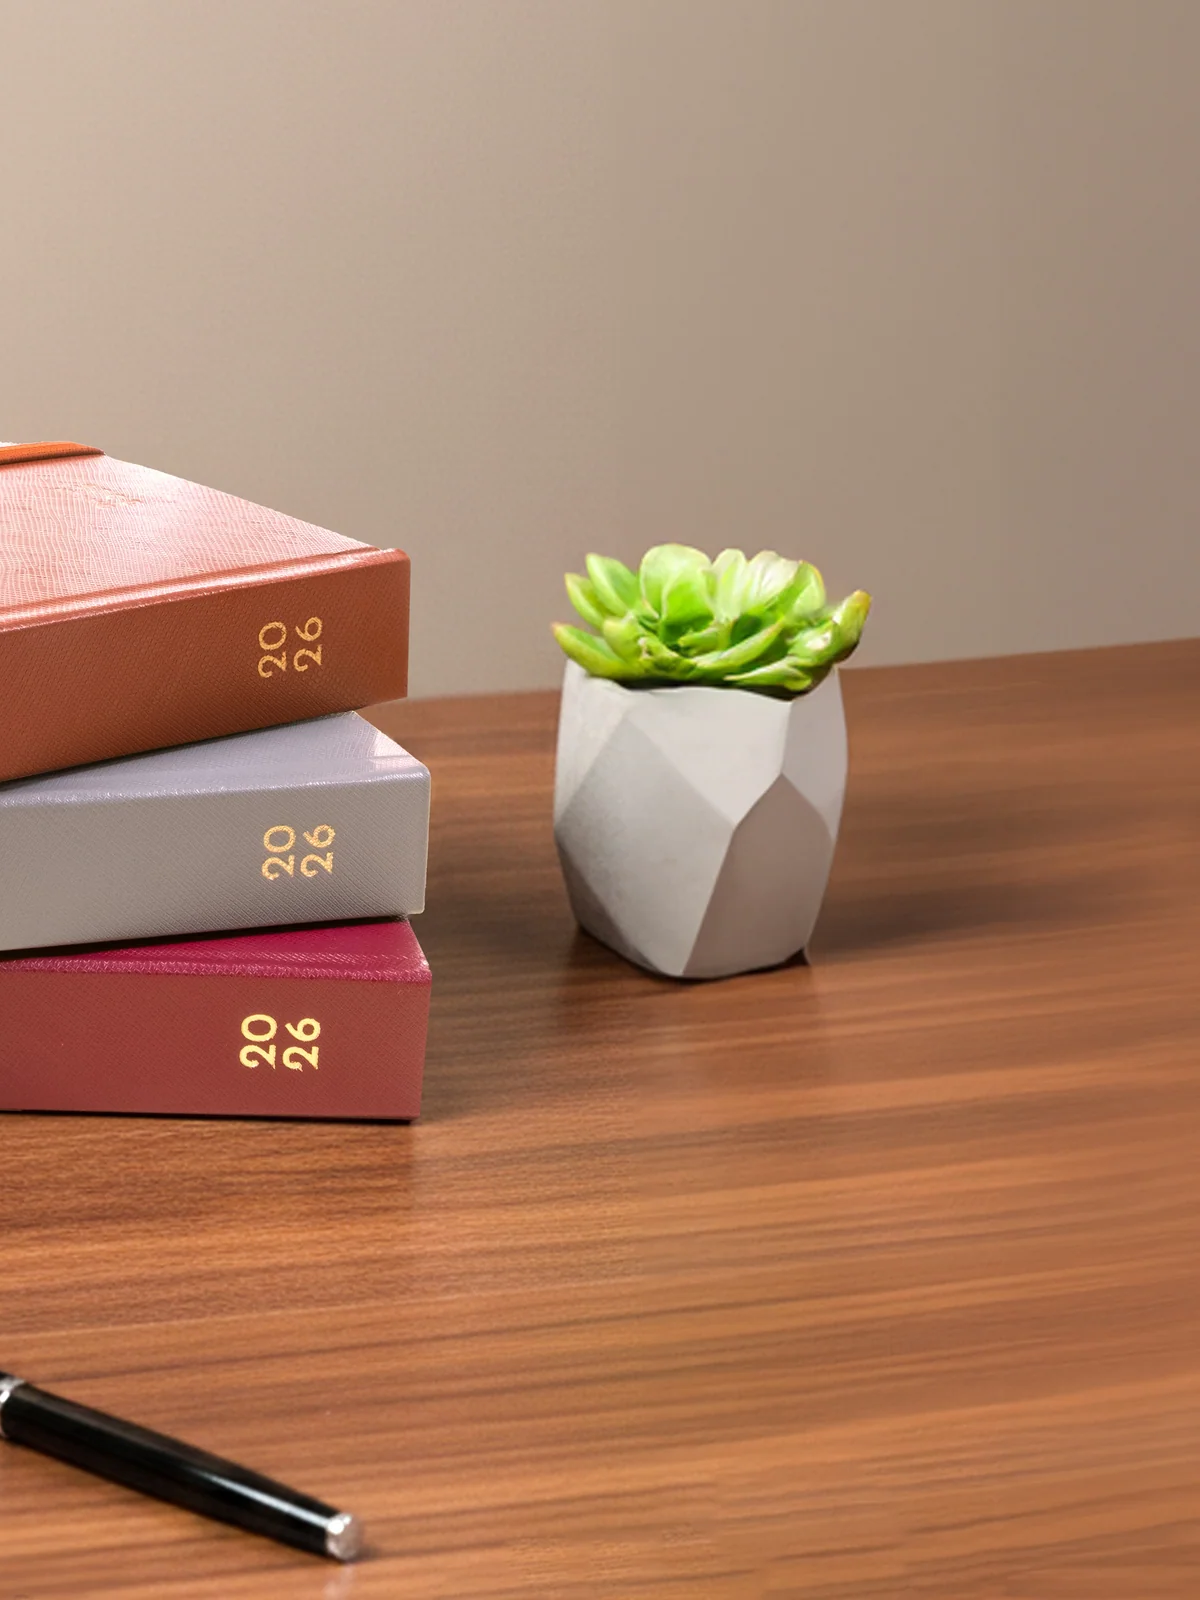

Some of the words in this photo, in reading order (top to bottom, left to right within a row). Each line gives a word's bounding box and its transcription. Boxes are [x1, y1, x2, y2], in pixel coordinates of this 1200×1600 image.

[257, 620, 288, 678] 20
[293, 616, 323, 672] 26
[261, 824, 297, 880] 20
[300, 823, 336, 877] 26
[238, 1013, 278, 1070] 20
[282, 1017, 322, 1072] 26
